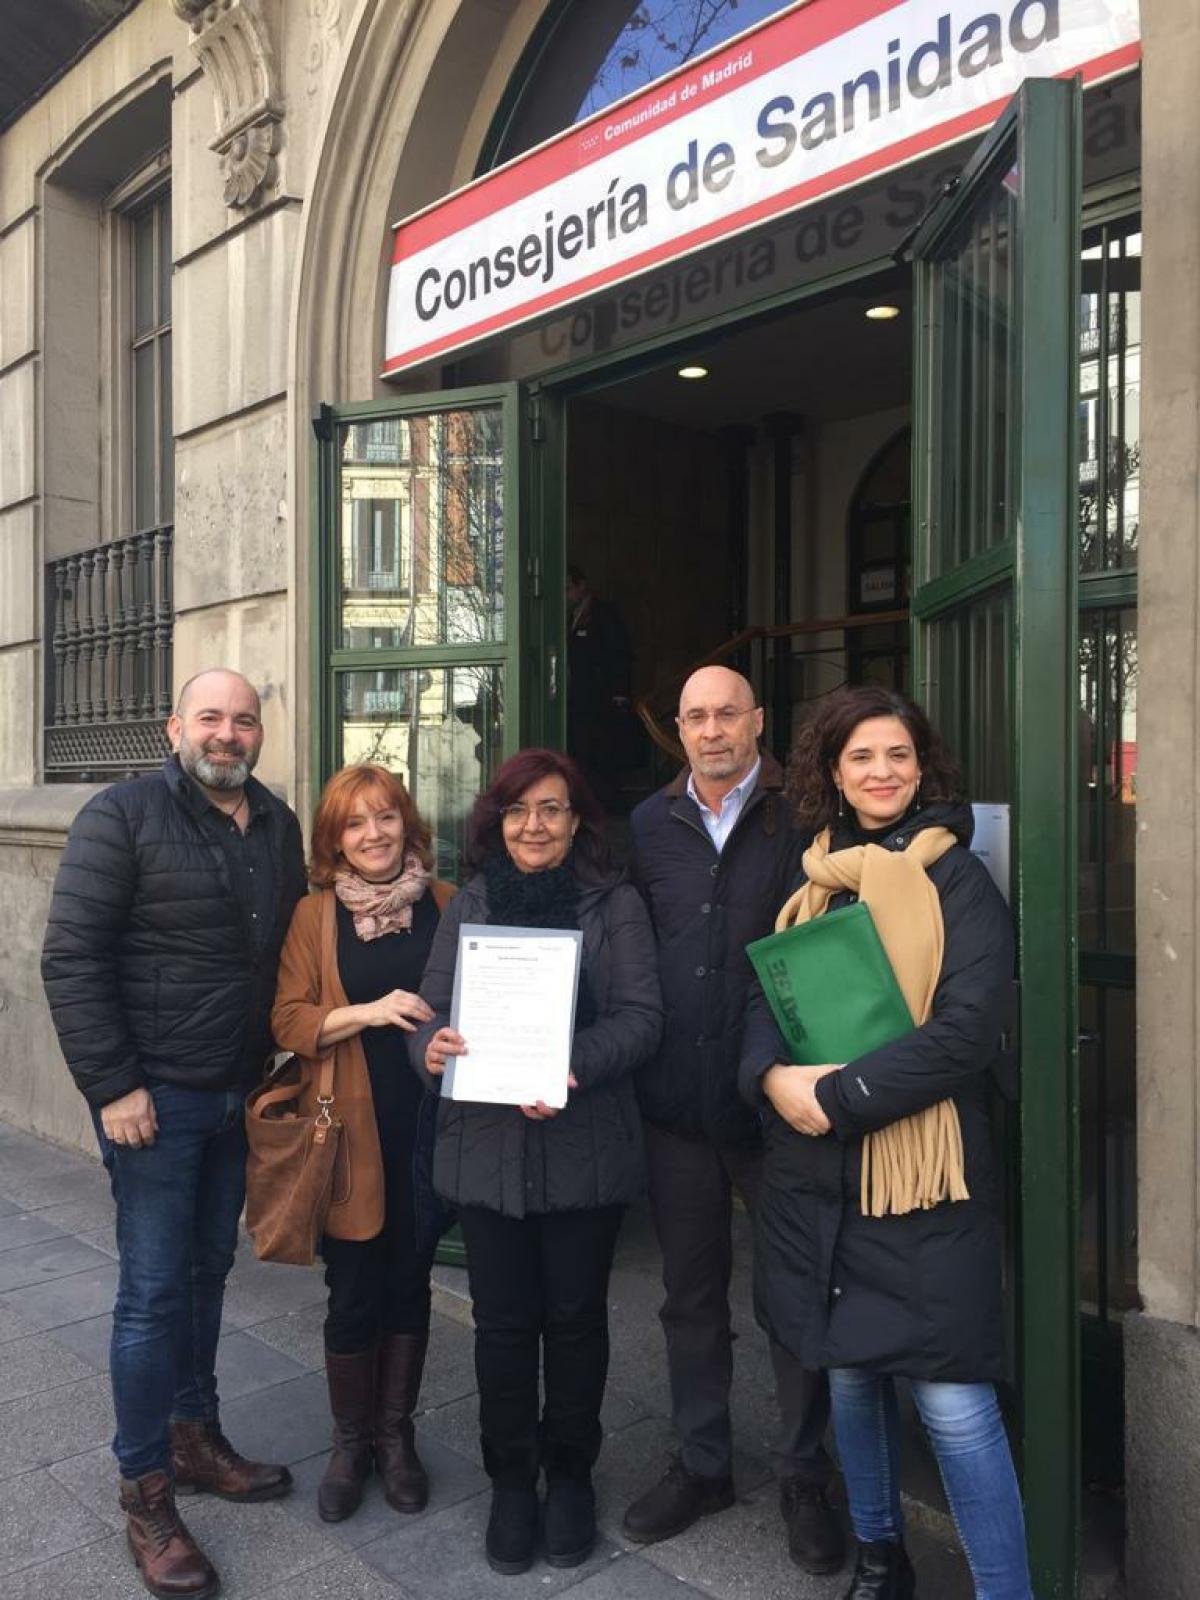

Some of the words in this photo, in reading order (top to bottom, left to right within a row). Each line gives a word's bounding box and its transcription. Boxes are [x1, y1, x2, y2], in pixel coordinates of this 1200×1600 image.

[415, 176, 648, 321] Consejería
[666, 138, 735, 212] de
[755, 0, 1060, 169] Sanidad
[603, 93, 677, 141] Comunidad
[680, 83, 698, 102] de
[702, 51, 753, 90] Madrid
